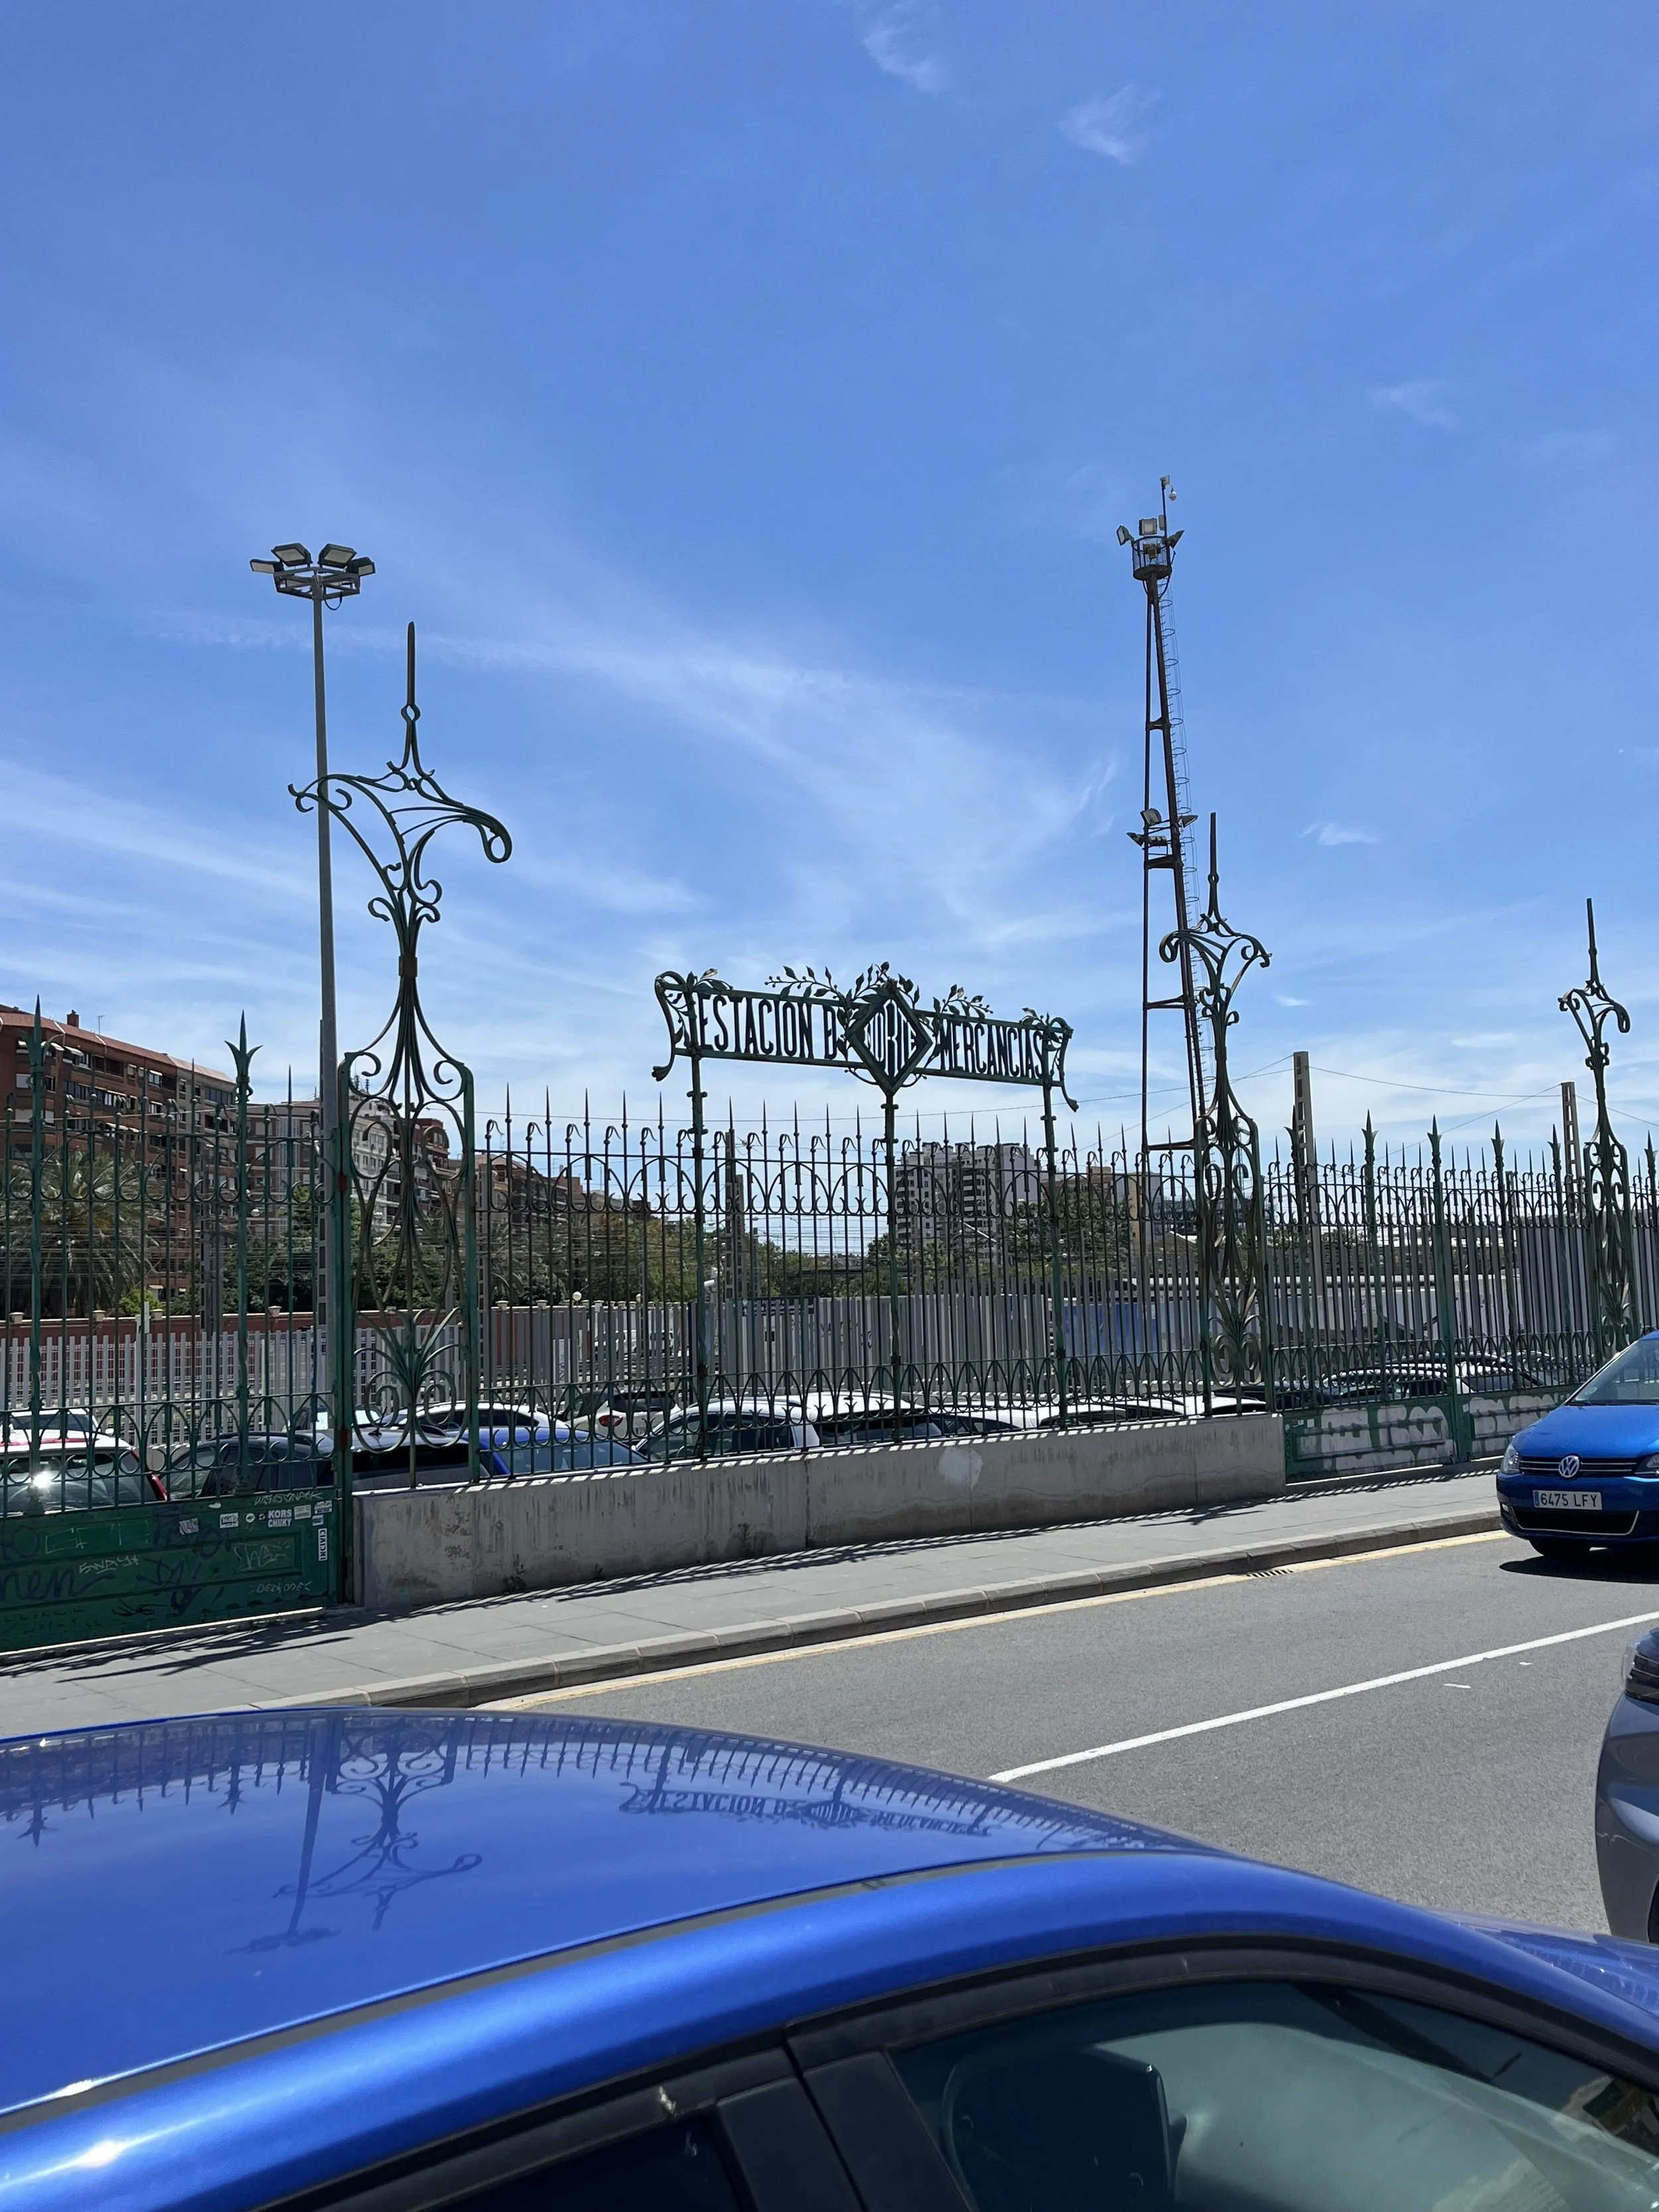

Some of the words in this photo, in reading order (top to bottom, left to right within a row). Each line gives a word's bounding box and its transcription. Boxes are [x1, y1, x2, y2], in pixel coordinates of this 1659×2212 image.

[698, 992, 814, 1059] ESTACION
[940, 1018, 1044, 1079] MERCANCIAS
[1541, 1493, 1569, 1506] 6475
[1573, 1494, 1597, 1507] LFY
[268, 1509, 292, 1518] KORS
[267, 1518, 292, 1528] CHUKY
